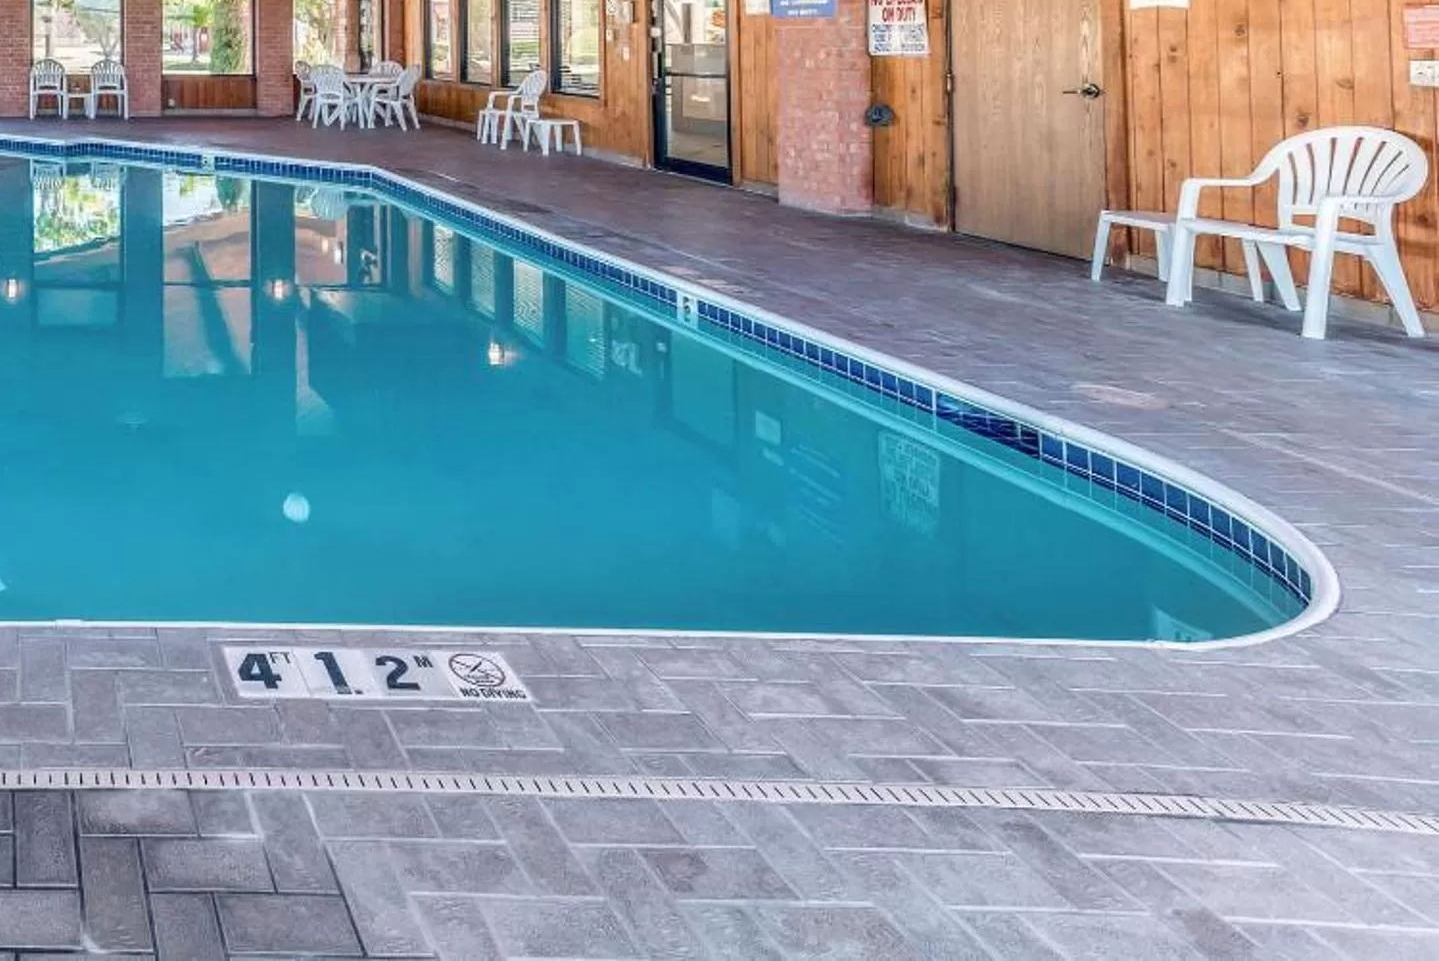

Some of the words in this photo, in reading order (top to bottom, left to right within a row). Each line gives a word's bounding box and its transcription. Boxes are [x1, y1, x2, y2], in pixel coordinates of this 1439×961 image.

[882, 7, 895, 23] ON
[896, 7, 916, 22] DUTY
[459, 687, 480, 698] NO
[480, 688, 527, 700] DIVING
